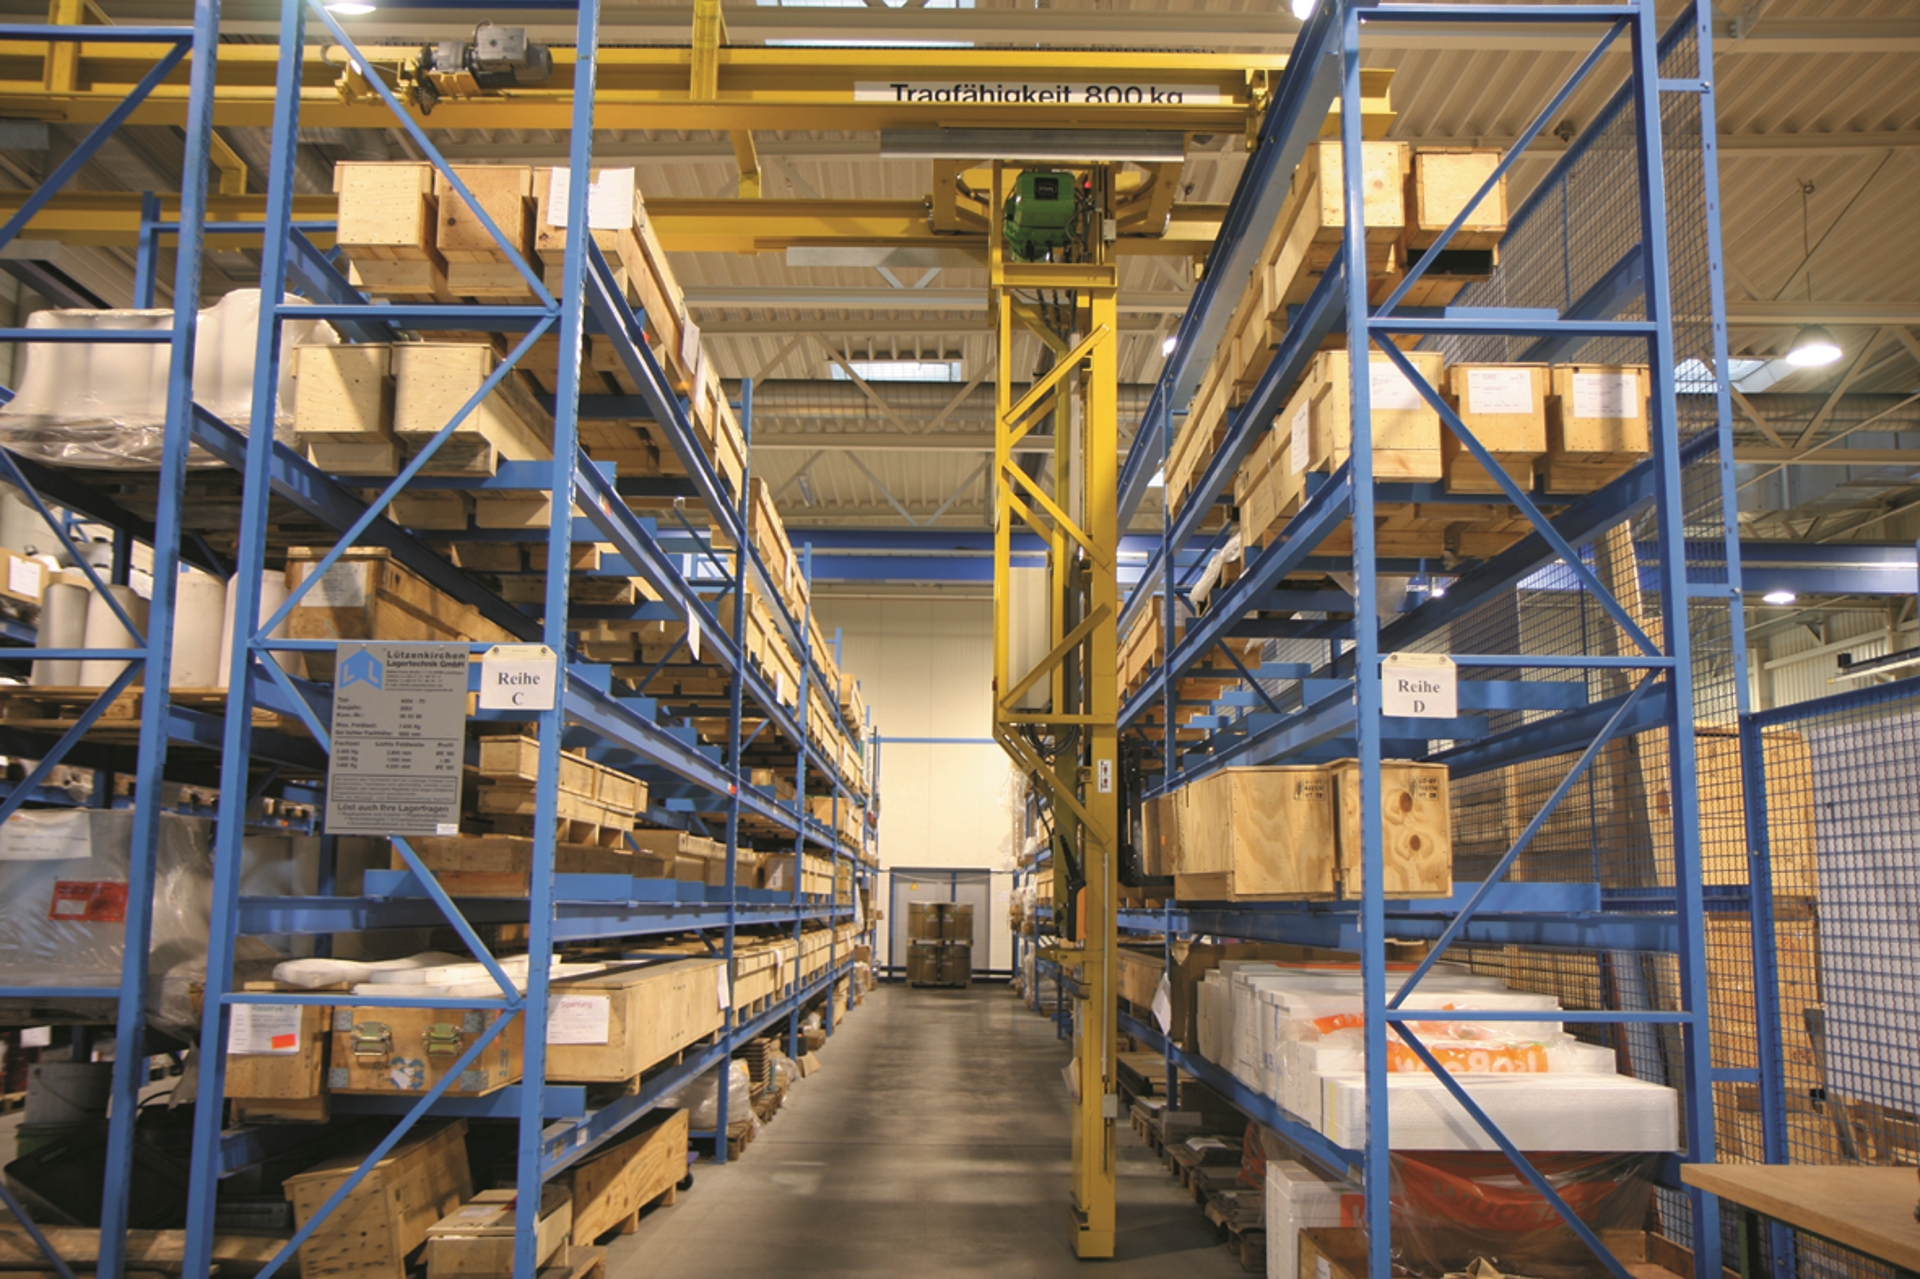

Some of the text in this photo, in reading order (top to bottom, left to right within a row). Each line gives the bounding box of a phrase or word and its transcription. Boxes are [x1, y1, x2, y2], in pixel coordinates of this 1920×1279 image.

[889, 83, 1184, 105] Tragfähigkeit 800 kg
[387, 650, 466, 659] Lützenkirchen
[386, 660, 466, 668] Lagertechnik GmbH
[498, 672, 541, 685] Reihe
[1397, 679, 1441, 693] Reihe
[512, 692, 524, 706] C
[1413, 700, 1426, 713] D
[338, 803, 356, 811] Löst
[380, 804, 397, 812] Ihre
[398, 805, 449, 813] Lagerfragen
